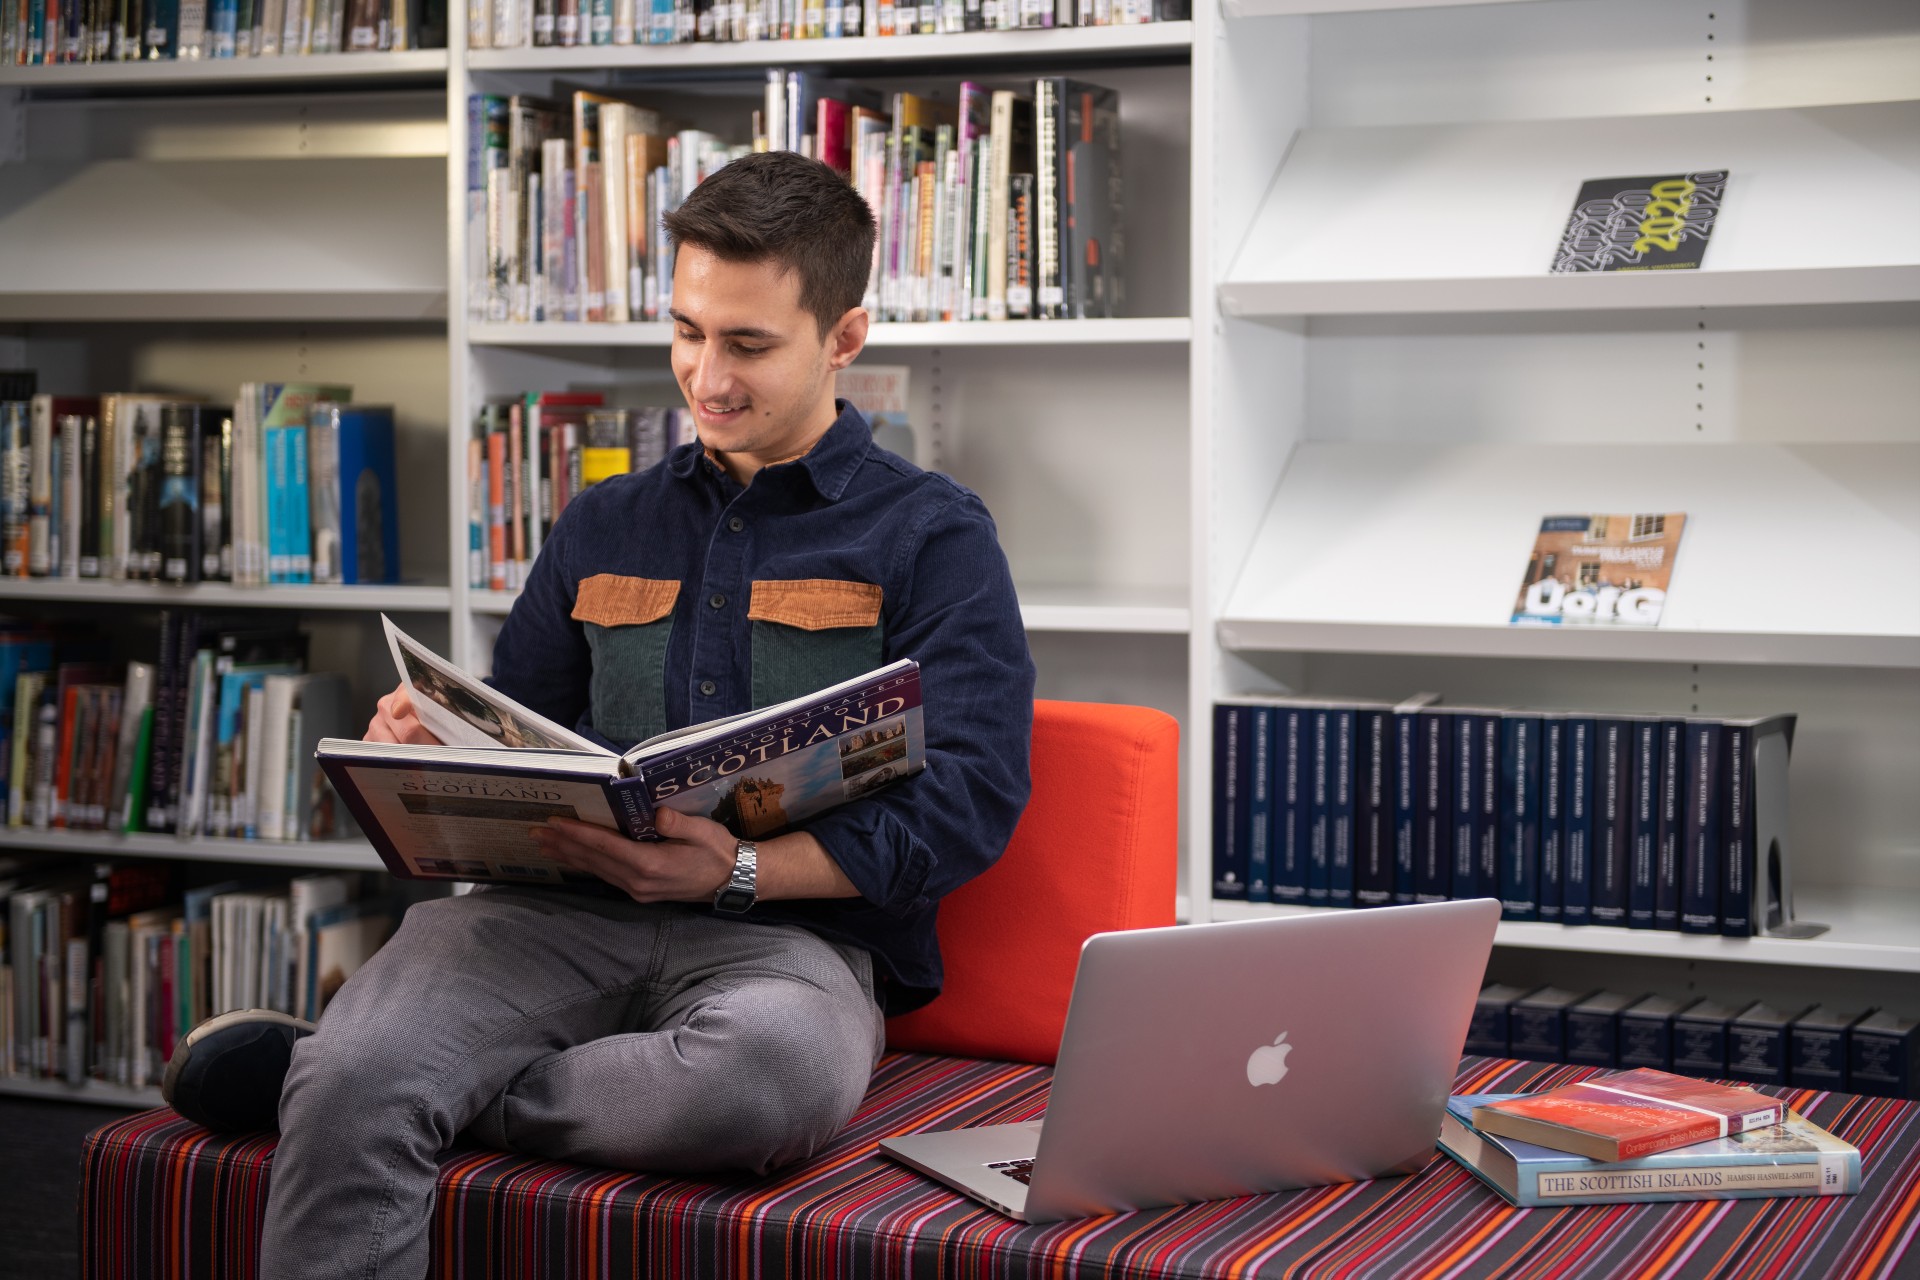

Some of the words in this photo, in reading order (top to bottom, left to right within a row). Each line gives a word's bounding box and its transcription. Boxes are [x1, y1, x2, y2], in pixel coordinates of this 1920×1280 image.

[1634, 180, 1696, 253] 2020
[1525, 581, 1667, 626] UofG
[646, 754, 692, 776] THE
[718, 678, 905, 749] ILLUSTRATED
[654, 696, 905, 800] SCOTLAND
[689, 720, 810, 770] HISTORY
[834, 700, 866, 717] OF
[402, 782, 562, 801] SCOTLAND
[620, 789, 639, 816] HISTORY
[630, 816, 642, 825] OF
[1625, 1137, 1670, 1154] Contemporary
[1669, 1131, 1689, 1145] British
[1689, 1126, 1716, 1140] Novelists
[1545, 1177, 1575, 1192] THE
[1579, 1175, 1653, 1191] SCOTTISH
[1657, 1172, 1723, 1189] ISLANDS
[1727, 1174, 1756, 1183] HAMISH
[1756, 1172, 1815, 1182] HASWELL-SMITH
